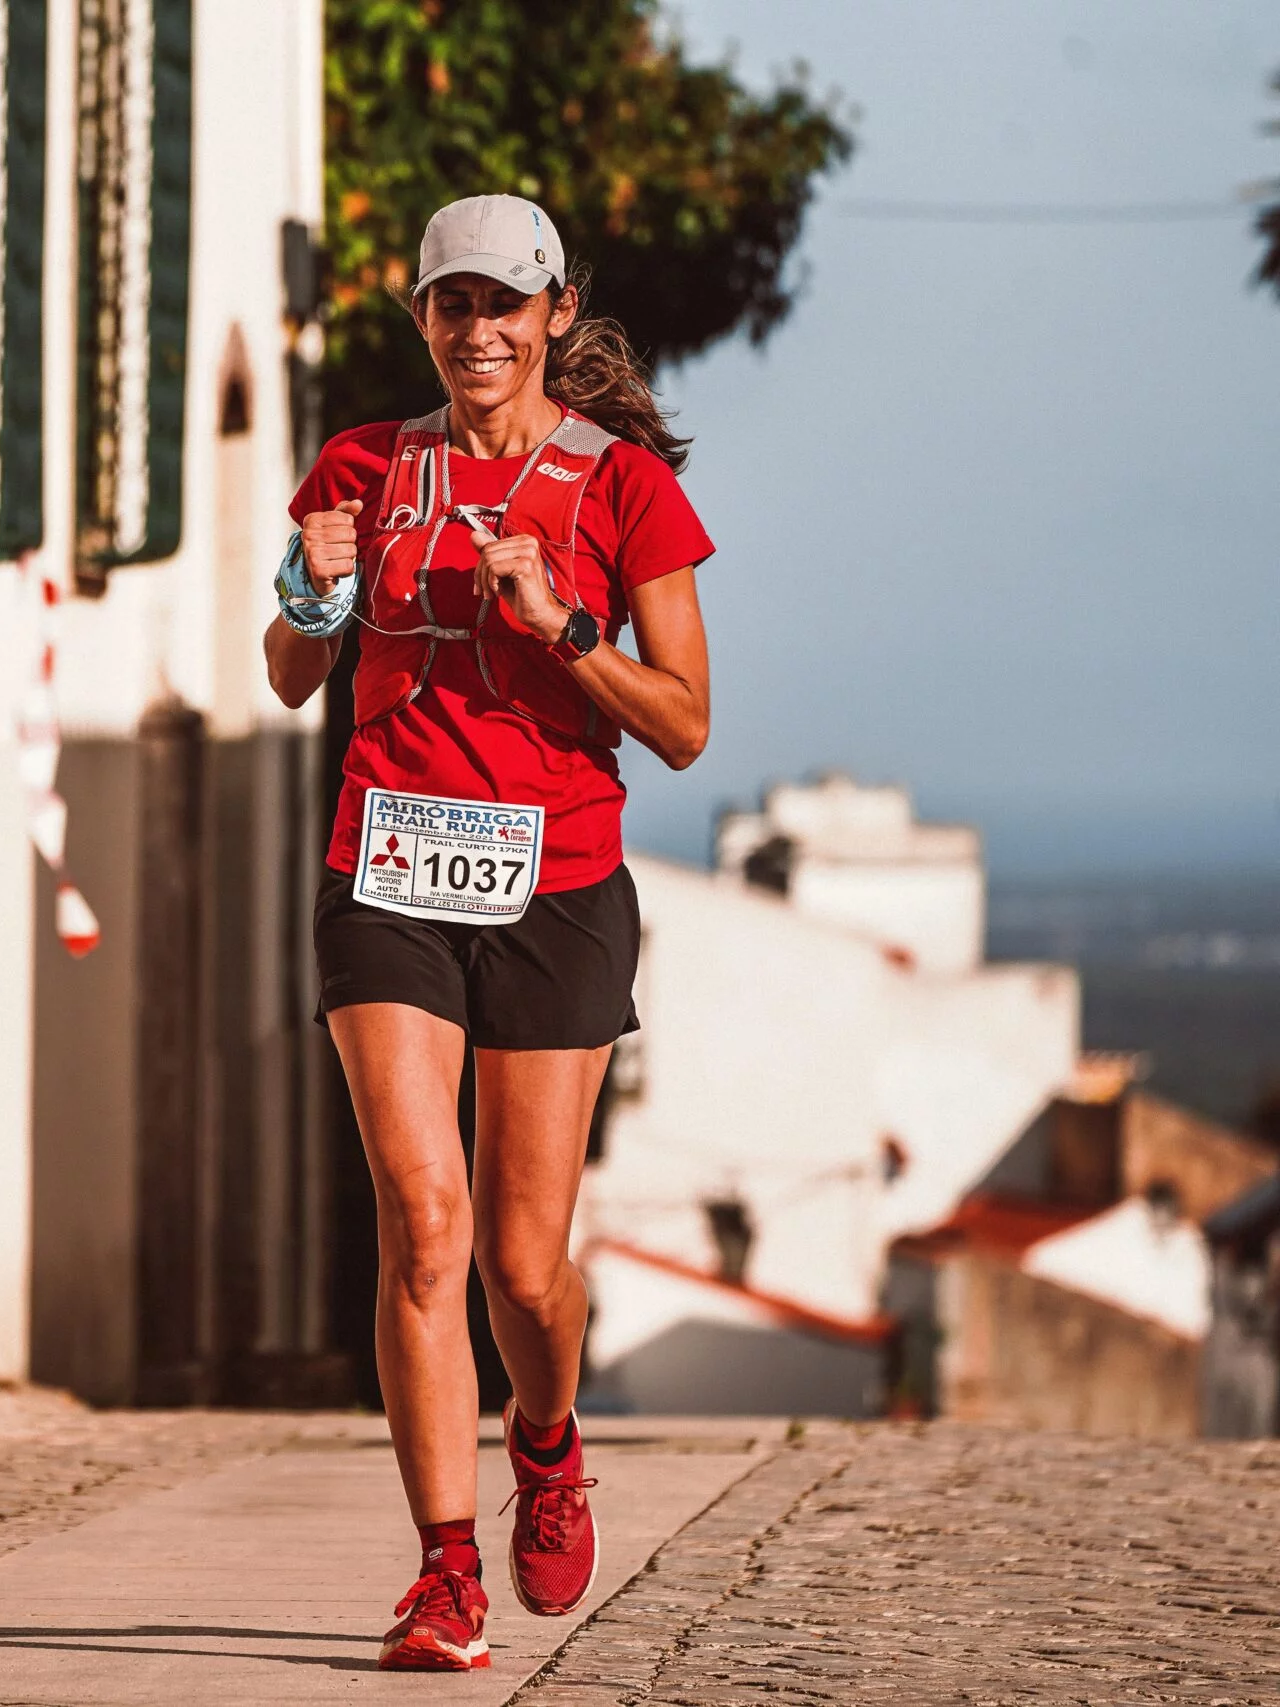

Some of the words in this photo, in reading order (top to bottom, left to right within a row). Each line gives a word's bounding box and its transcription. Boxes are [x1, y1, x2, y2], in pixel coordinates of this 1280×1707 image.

[377, 799, 532, 828] MIRÓBRIGA
[377, 812, 440, 830] TRAIL
[446, 821, 495, 835] RUN
[405, 825, 453, 838] Setembro
[510, 834, 531, 843] Coragem
[423, 838, 455, 848] TRAIL
[457, 842, 496, 852] CURTO
[499, 846, 528, 855] 17KM
[370, 868, 409, 879] MITSUBISHI
[423, 852, 525, 896] 1037
[374, 876, 402, 885] MOTORS
[365, 888, 409, 902] CHARRETE
[376, 885, 399, 893] AUTO
[423, 898, 436, 906] 356
[441, 892, 486, 902] VERMELHUDO
